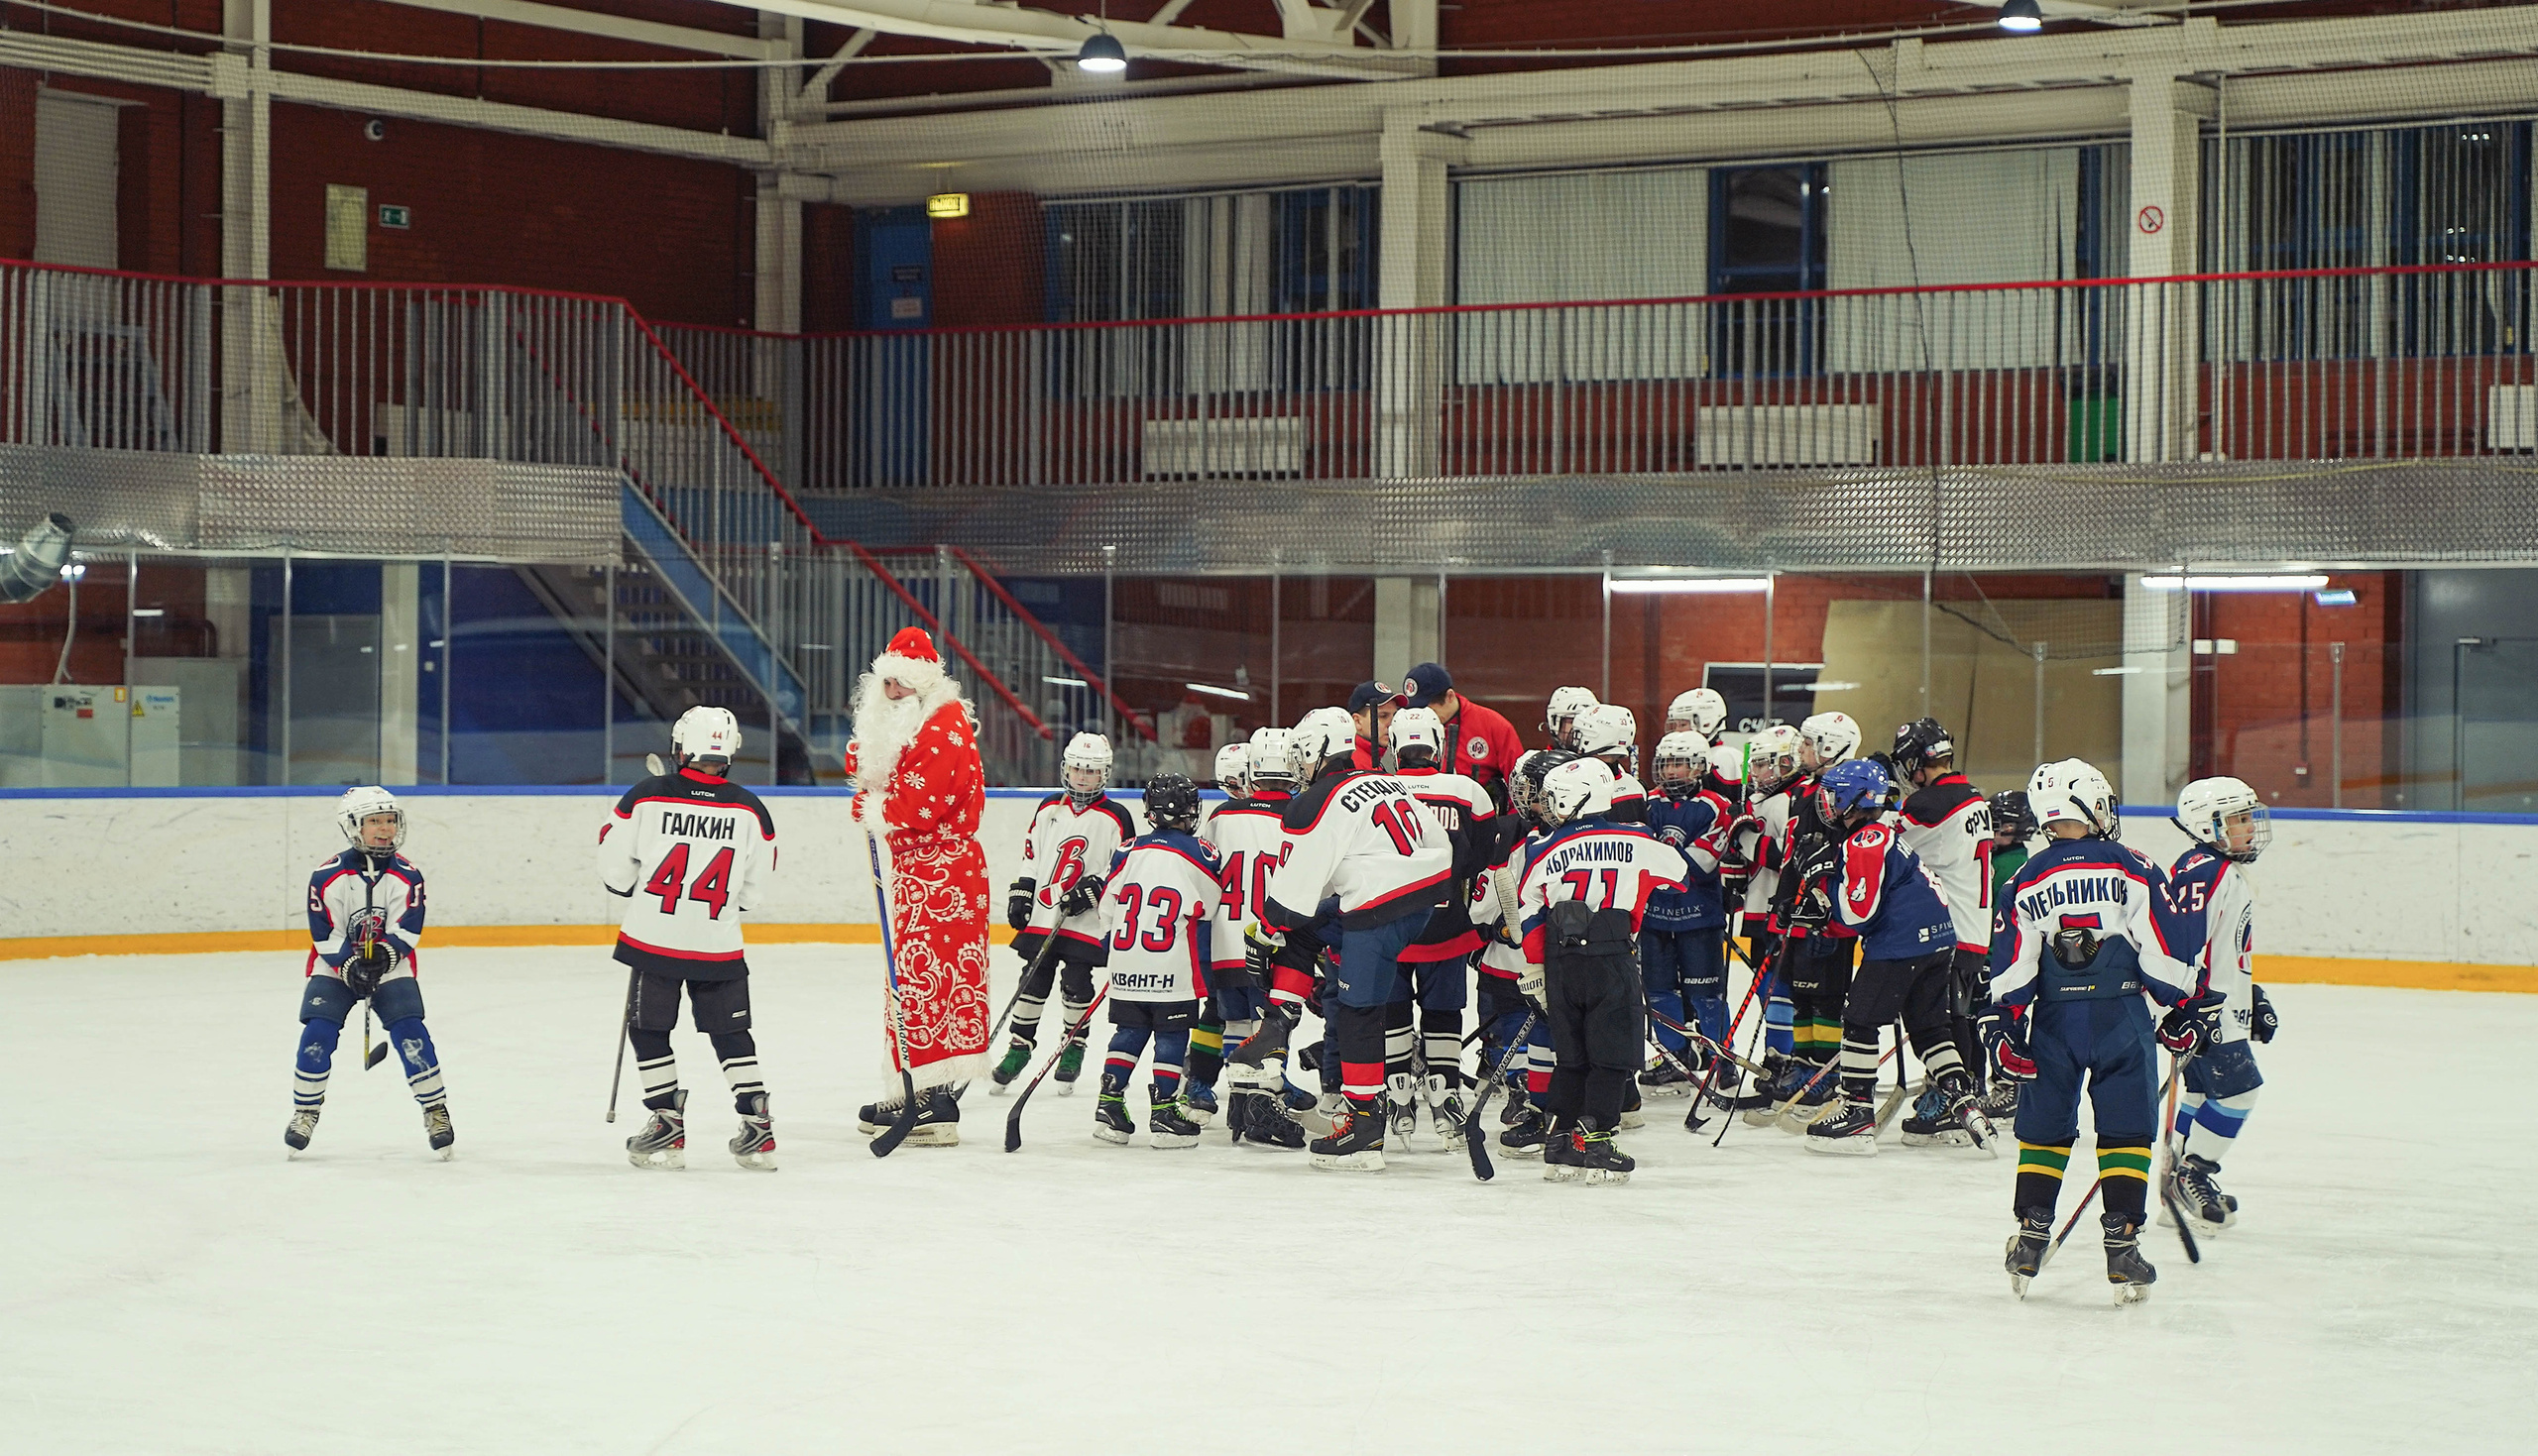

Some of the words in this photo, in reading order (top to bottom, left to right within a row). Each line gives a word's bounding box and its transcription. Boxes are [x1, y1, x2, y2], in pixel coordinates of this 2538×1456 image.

[1738, 718, 1784, 733] СЧТ
[2047, 777, 2054, 788] 5
[662, 811, 736, 840] ГАЛКИН
[1371, 800, 1426, 857] 10
[1546, 840, 1634, 876] АБДРАХИМОВ
[644, 842, 737, 921] 44
[1561, 868, 1619, 910] 71
[1113, 882, 1182, 952] 33
[1649, 904, 1701, 917] PINETIX
[1111, 972, 1175, 989] КВАНТ-Н
[895, 1009, 910, 1062] NORDWAY
[1490, 1011, 1537, 1084] SHERWOOD
